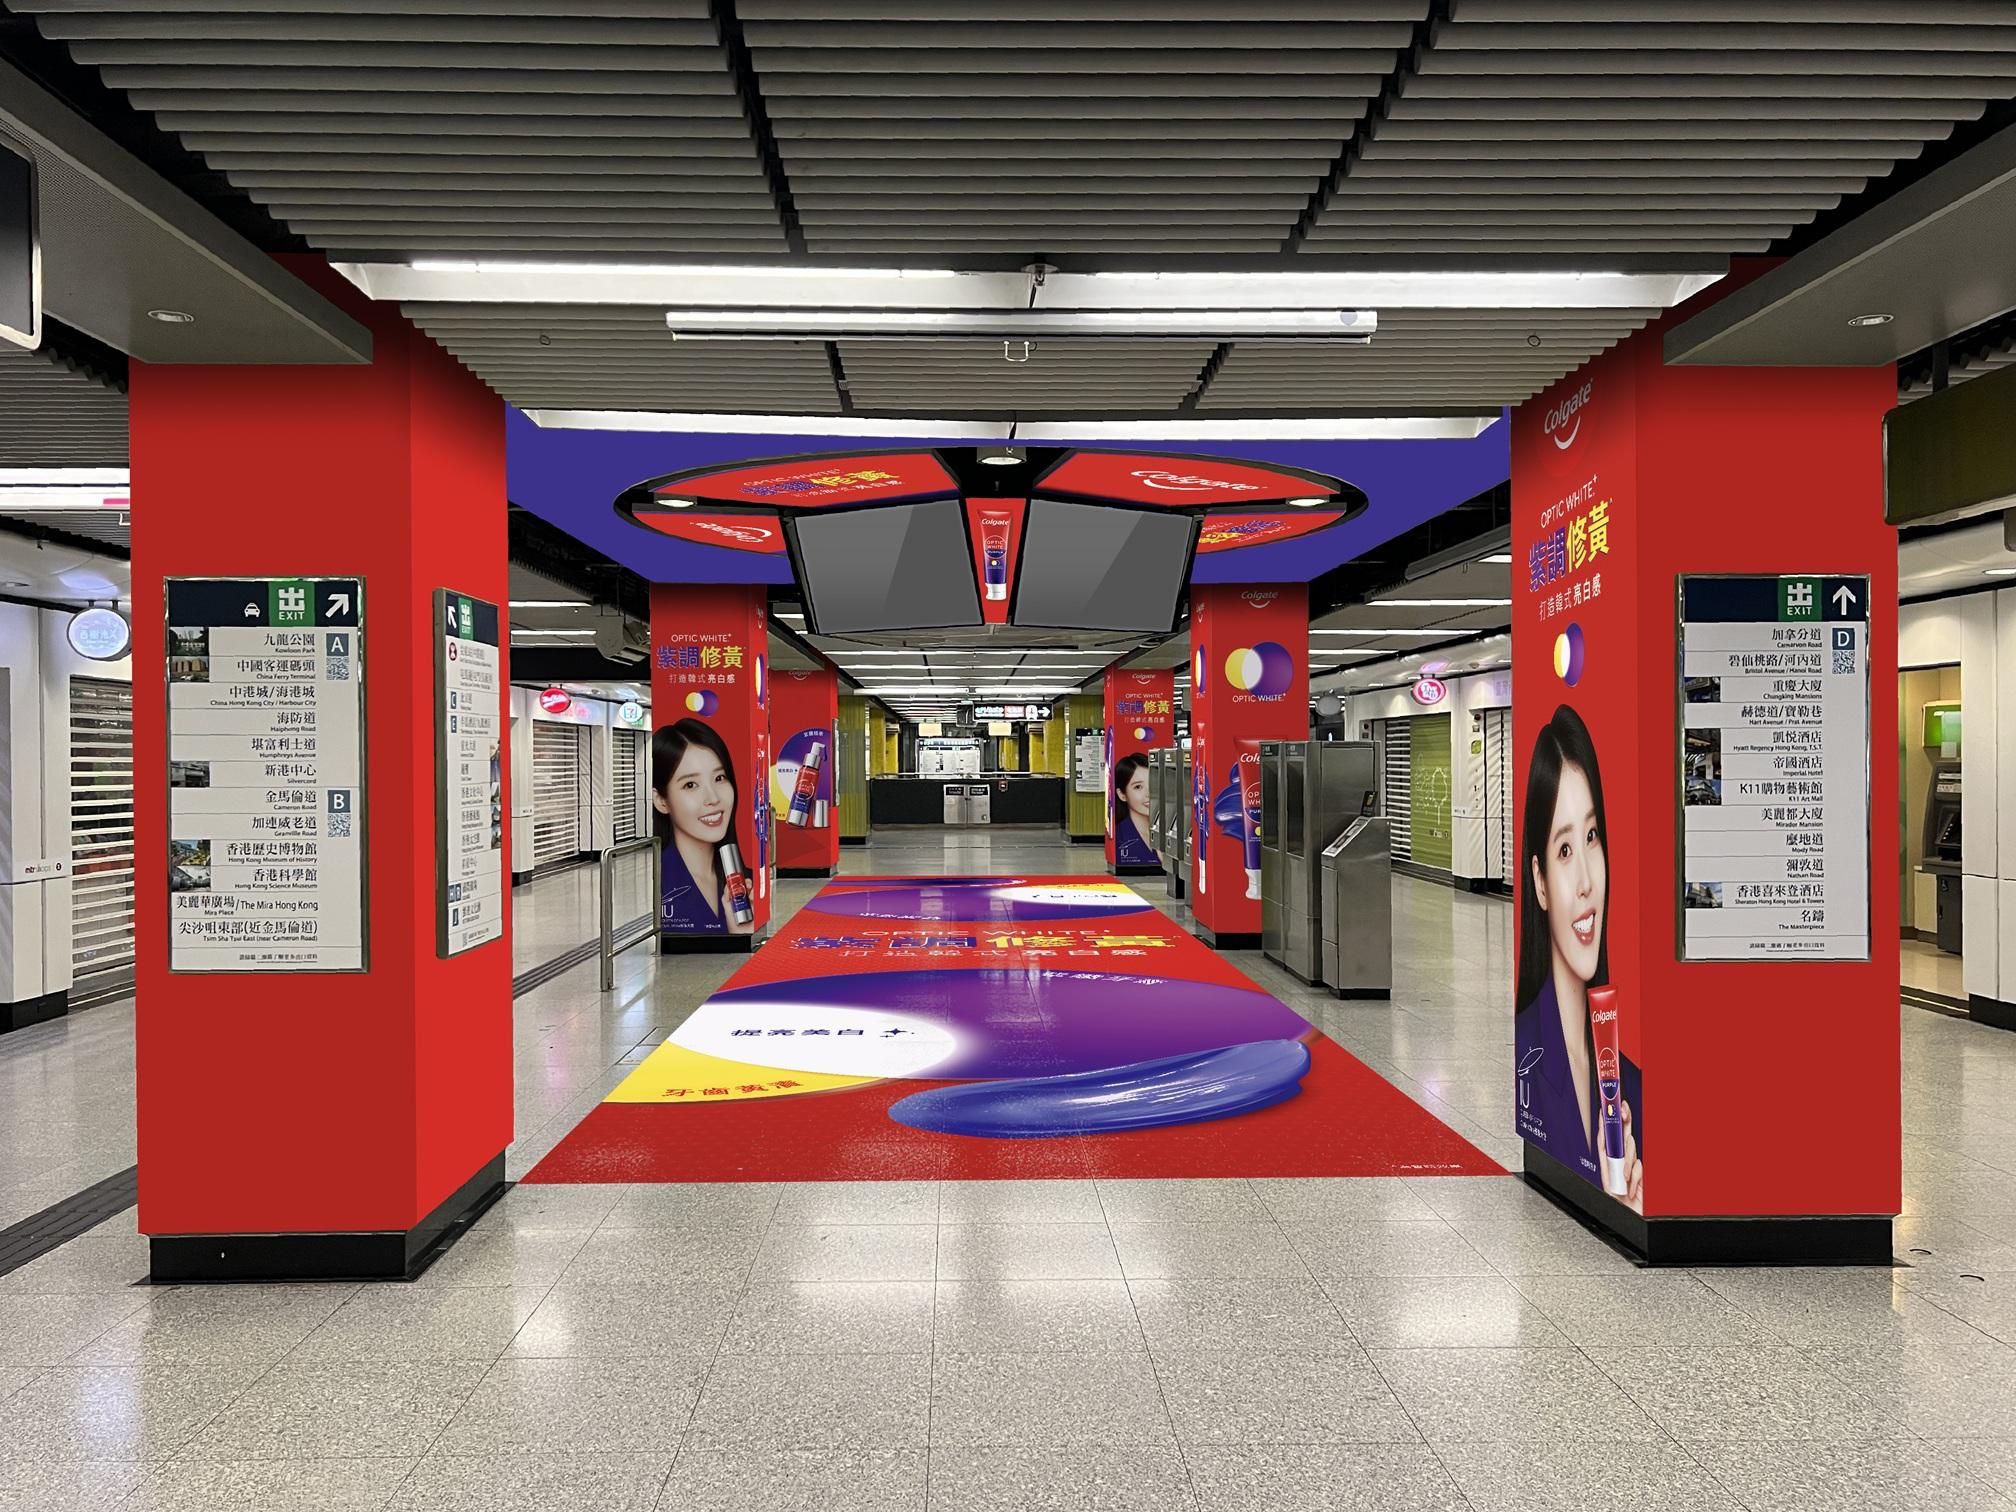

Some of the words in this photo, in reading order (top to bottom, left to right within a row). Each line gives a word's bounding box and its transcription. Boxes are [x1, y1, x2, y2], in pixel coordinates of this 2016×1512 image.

[1544, 383, 1592, 434] Colgate
[1130, 470, 1259, 490] Colgate
[1540, 500, 1564, 528] OPTIC
[981, 518, 1009, 526] Colgate
[1528, 501, 1610, 592] 紫調修黃
[279, 587, 304, 611] 出
[1241, 591, 1279, 601] Colgate
[1539, 572, 1601, 622] 打造韓式亮白感
[1788, 582, 1812, 606] 出
[264, 633, 315, 646] 九龍公園
[671, 634, 698, 643] OPTIC
[1772, 628, 1822, 642] 加拿分道
[1837, 631, 1850, 647] D
[331, 637, 344, 652] A
[656, 646, 744, 669] 紫調修黃
[237, 659, 315, 673] 中國客運碼頭
[669, 674, 736, 684] 打造韓式亮白感
[229, 685, 315, 698] 中港城/海港城
[1232, 694, 1256, 703] OPTIC
[277, 711, 316, 724] 海防道
[251, 738, 316, 751] 堪富利士道
[1773, 756, 1822, 769] 帝國酒店
[265, 763, 317, 777] 新港中心
[1740, 781, 1823, 795] K11購物藝術館
[265, 790, 317, 803] 金馬倫道
[333, 793, 345, 810] B
[252, 816, 317, 829] 加連威老道
[226, 842, 317, 856] 香港歷史博物館
[1786, 858, 1824, 872] 彌敦道
[253, 868, 318, 882] 香港科學館
[1738, 884, 1824, 898] 香港喜來登酒店
[256, 900, 274, 910] Mira
[275, 900, 296, 911] Hong
[298, 900, 318, 911] Kong
[1801, 909, 1824, 923] 名鑄
[1592, 1010, 1617, 1024] Colgate
[730, 1028, 864, 1036] 提亮美白
[1600, 1060, 1615, 1068] OPTIC
